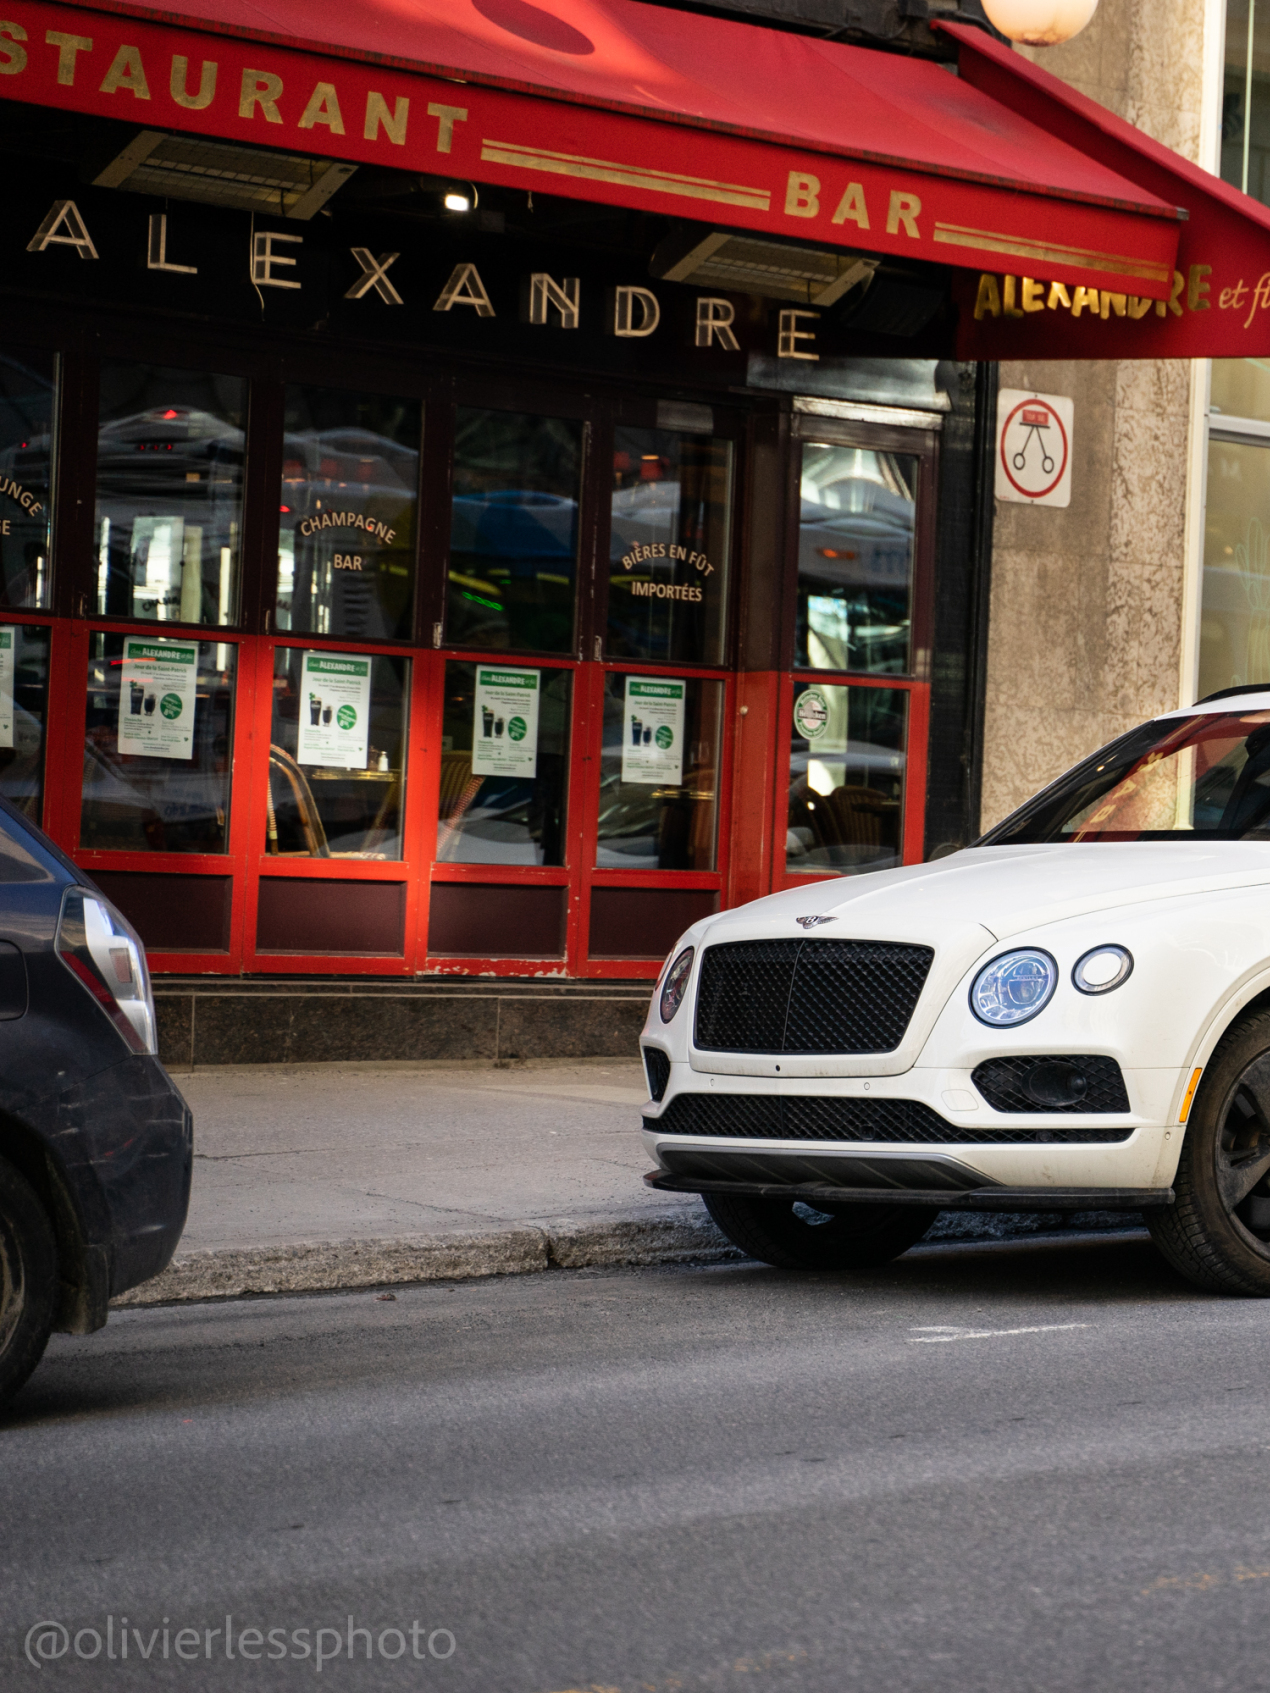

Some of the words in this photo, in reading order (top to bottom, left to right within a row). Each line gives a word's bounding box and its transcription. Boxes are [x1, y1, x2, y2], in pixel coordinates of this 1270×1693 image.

[784, 170, 923, 239] BAR
[26, 199, 821, 361] ALEXANDRE
[1219, 279, 1250, 310] et
[300, 511, 396, 544] CHAMPAGNE
[333, 554, 362, 571] BAR
[622, 543, 666, 570] BIÈRES
[669, 544, 687, 561] EN
[688, 551, 714, 576] FÛT
[632, 581, 702, 602] IMPORTÉES
[142, 647, 181, 660] ALEXANDRE
